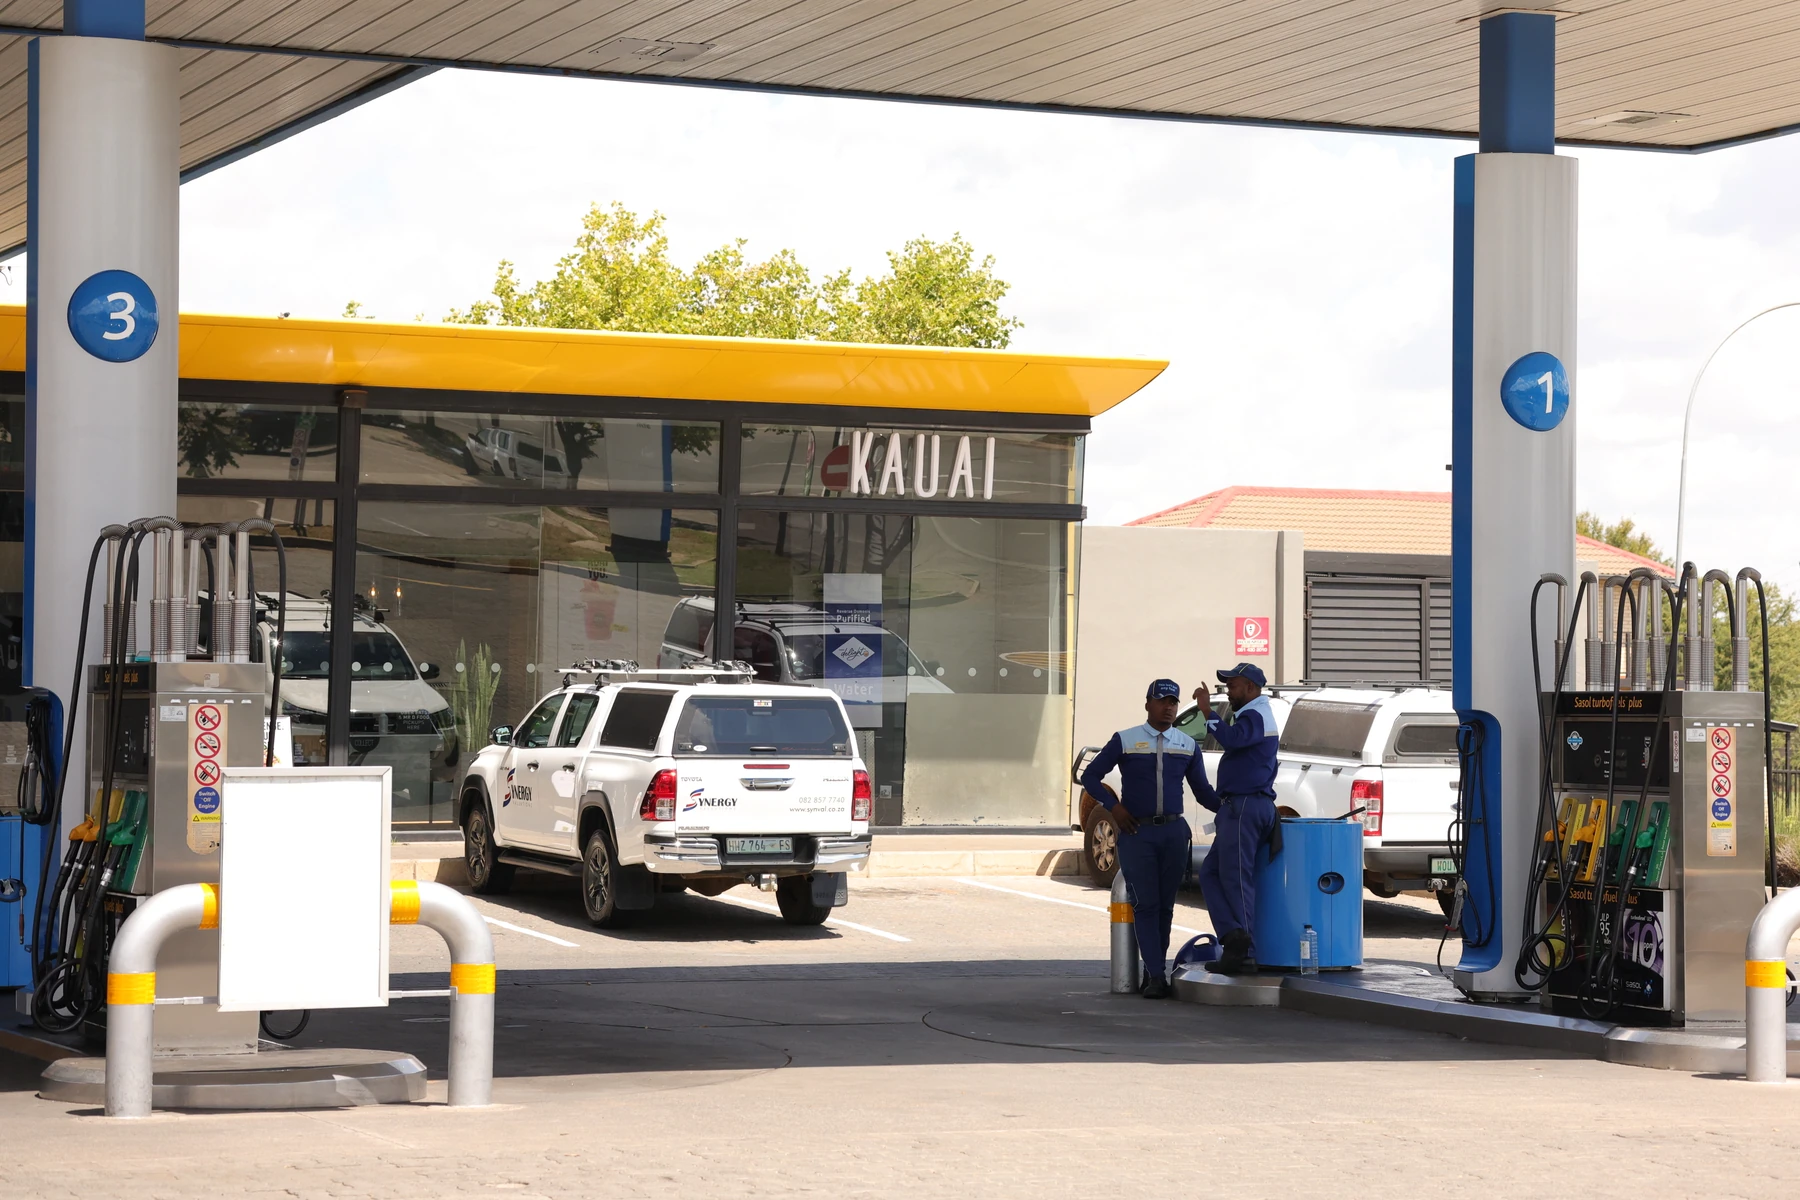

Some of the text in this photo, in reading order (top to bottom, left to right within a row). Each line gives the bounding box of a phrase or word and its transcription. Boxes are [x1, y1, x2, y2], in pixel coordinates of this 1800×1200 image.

[103, 292, 135, 340] 3
[1537, 371, 1553, 414] 1
[851, 430, 995, 499] KAUAI
[836, 614, 871, 622] Purified
[834, 683, 874, 695] Water
[1574, 696, 1591, 708] Sasol
[1628, 696, 1643, 711] plus
[683, 788, 738, 812] SYNERGY
[789, 805, 845, 815] www.synval.co.za
[748, 840, 766, 851] 764
[779, 840, 791, 851] FS
[1569, 888, 1587, 900] Sasol
[1600, 922, 1611, 936] 95
[1627, 922, 1658, 969] 10
[1643, 942, 1654, 951] ppm
